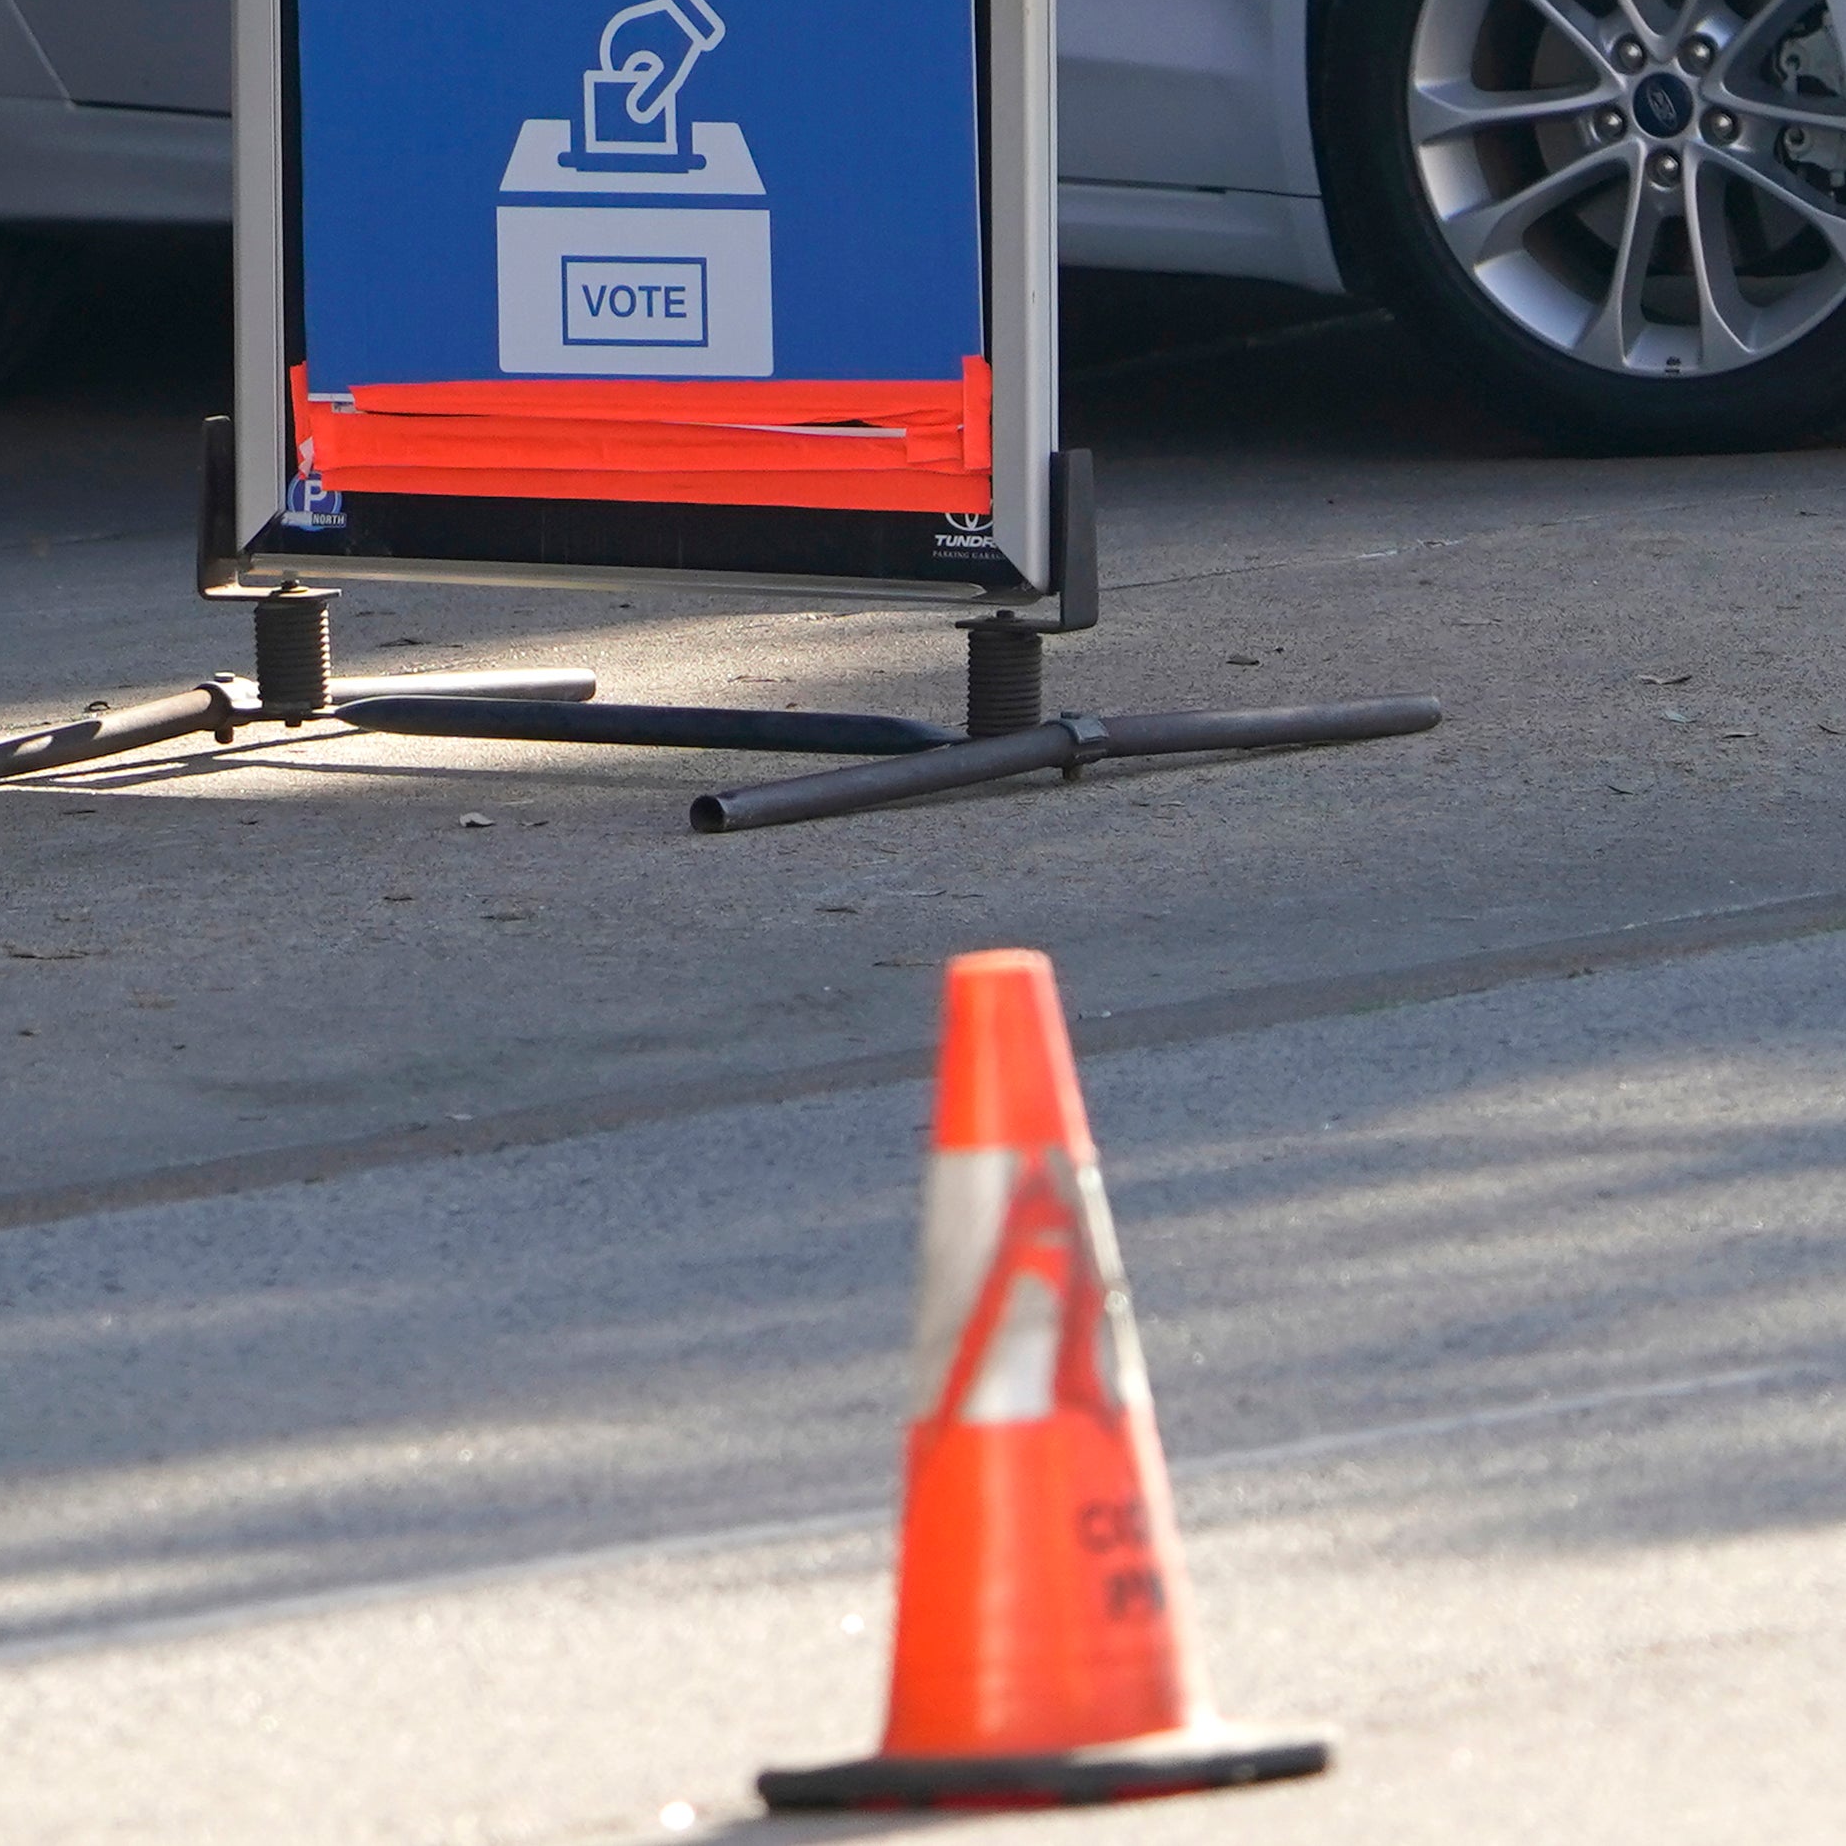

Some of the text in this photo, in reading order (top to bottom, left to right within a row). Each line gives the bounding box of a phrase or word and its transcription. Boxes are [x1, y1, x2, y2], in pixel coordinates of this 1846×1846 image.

[581, 283, 687, 319] VOTE
[312, 514, 345, 526] NORTH
[934, 534, 999, 548] TUNDR
